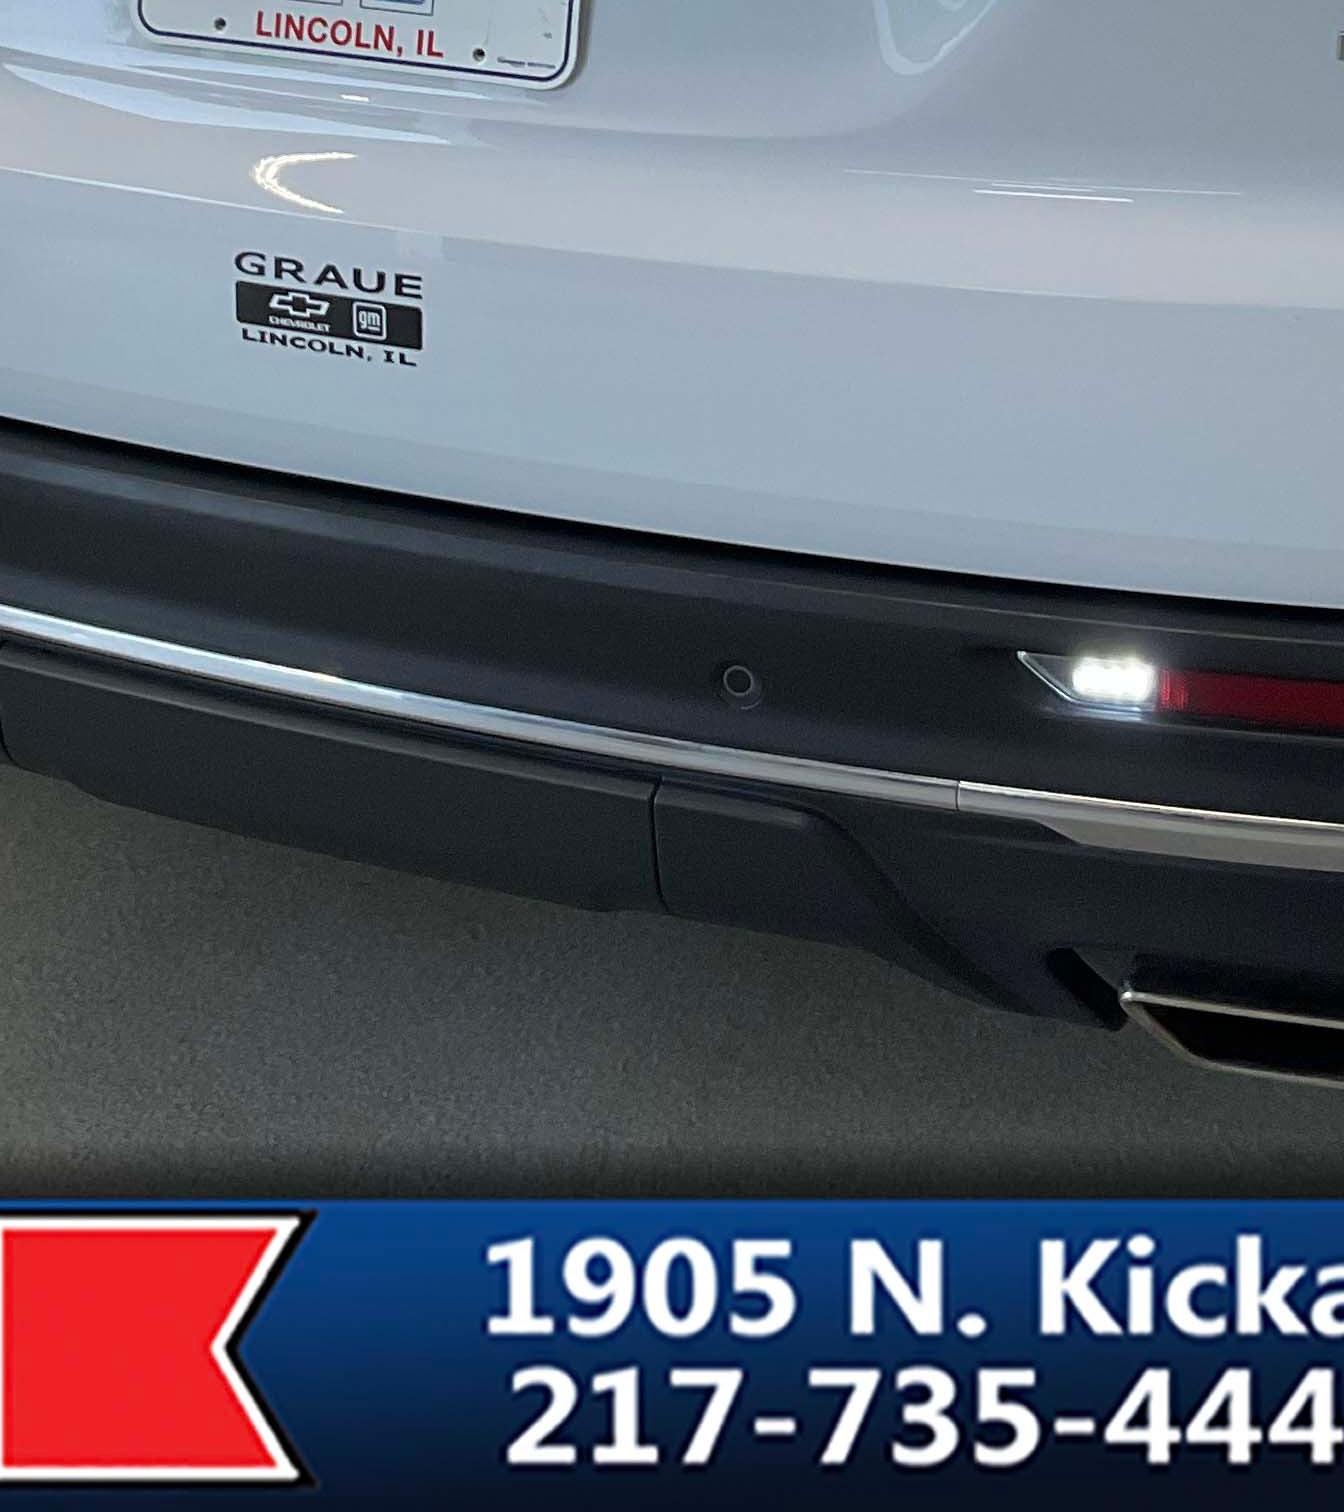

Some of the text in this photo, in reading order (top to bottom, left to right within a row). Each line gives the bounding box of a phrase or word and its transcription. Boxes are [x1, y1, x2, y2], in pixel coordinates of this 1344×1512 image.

[255, 11, 444, 59] LINCOLN, IL
[234, 251, 423, 299] GRAUE
[268, 315, 331, 333] CHEVROLET
[358, 309, 381, 331] gm
[242, 327, 417, 368] LINCOLN, IL
